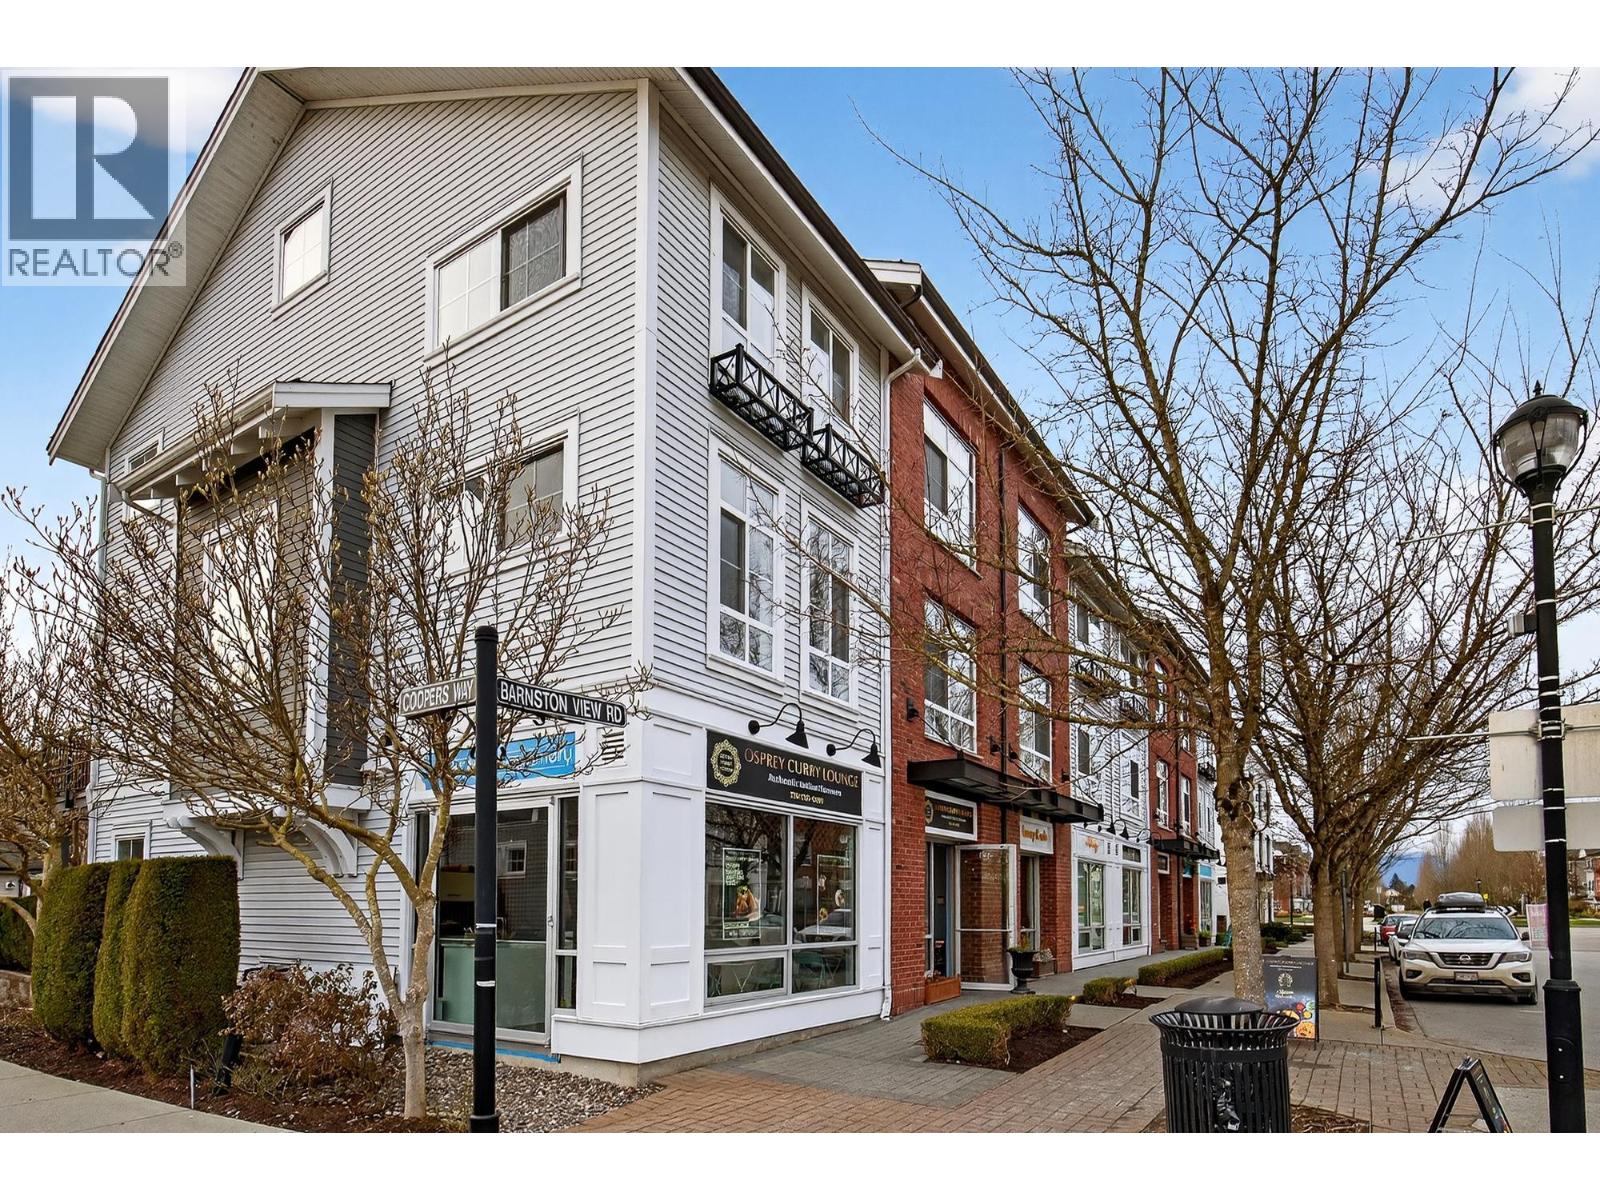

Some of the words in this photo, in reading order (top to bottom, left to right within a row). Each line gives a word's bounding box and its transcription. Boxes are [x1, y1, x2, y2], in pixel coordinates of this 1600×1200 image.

[402, 685, 449, 710] COOPERS
[453, 678, 475, 702] WAY
[500, 681, 569, 714] BARNSTON
[572, 698, 602, 720] VIEW
[606, 704, 623, 723] RD
[744, 748, 785, 769] OSPREY
[787, 758, 821, 778] CURRY
[822, 768, 859, 788] LOUNGE
